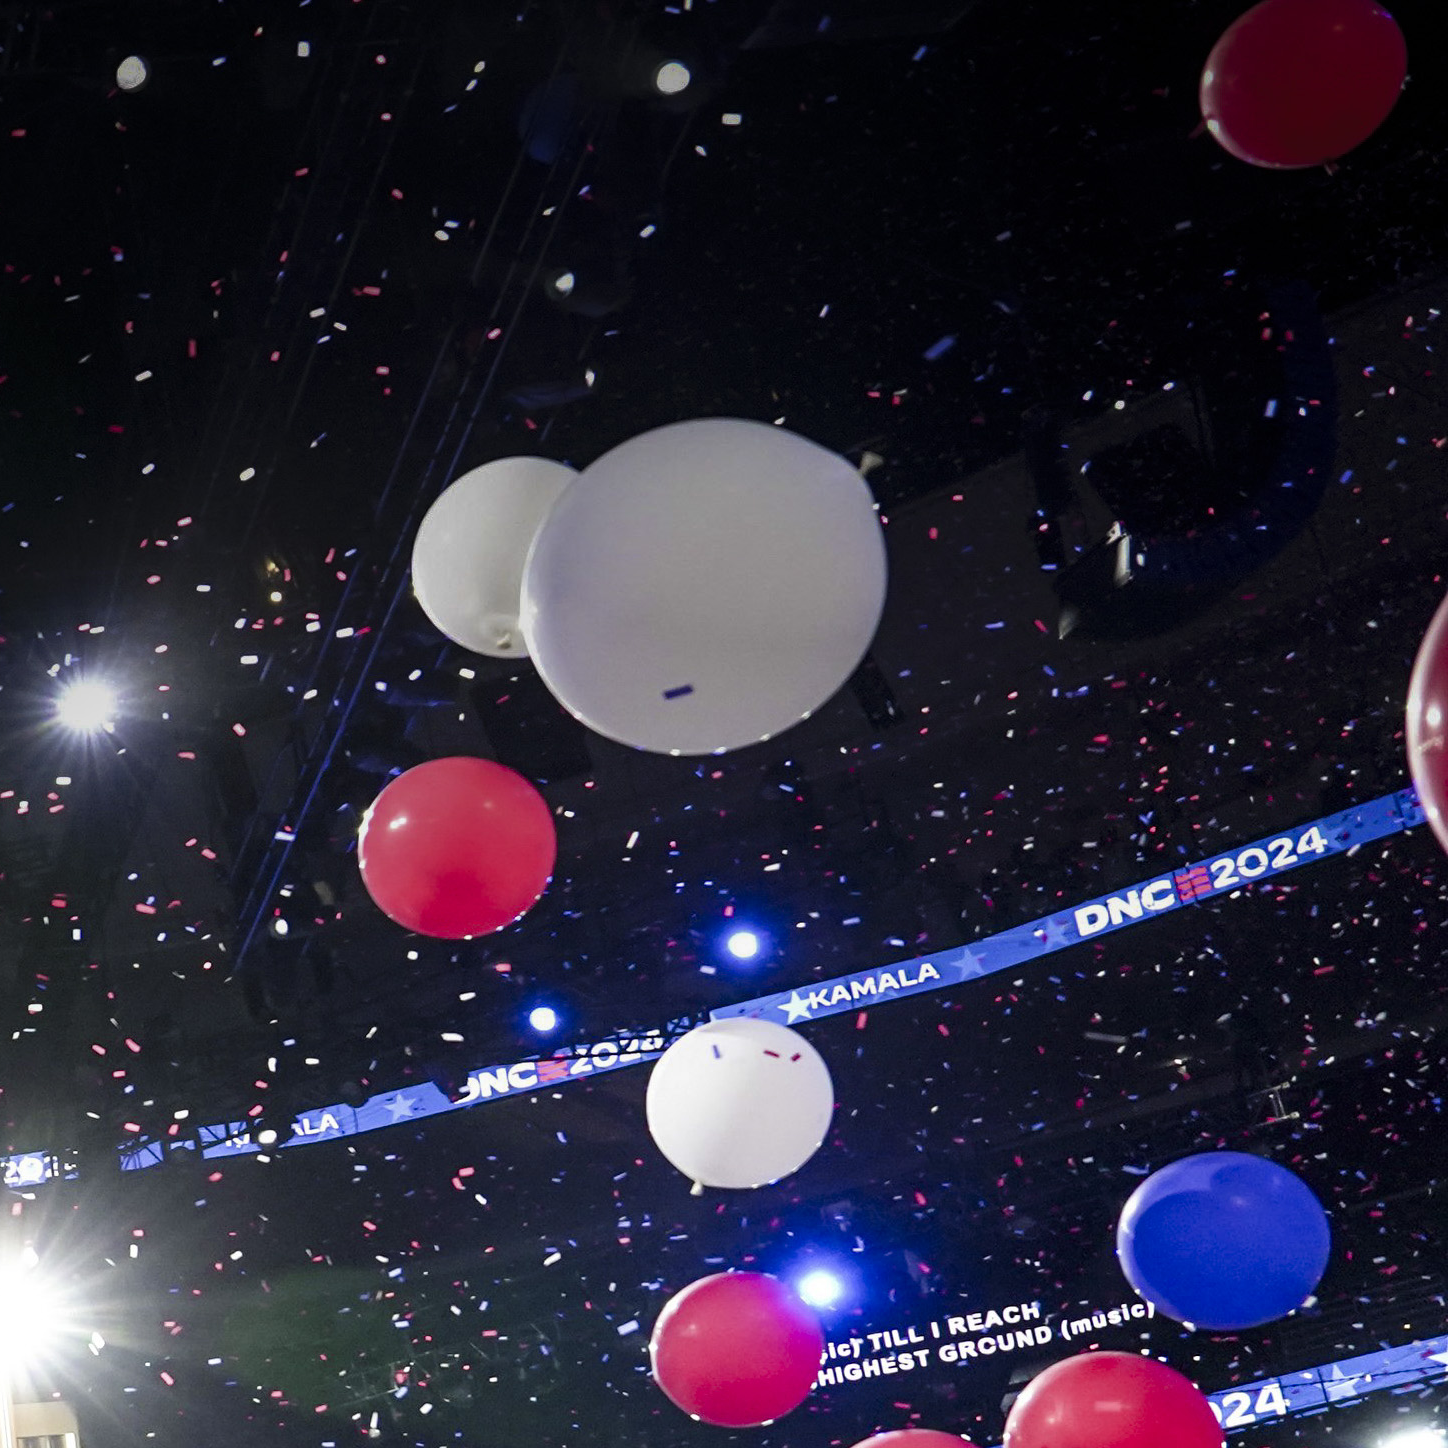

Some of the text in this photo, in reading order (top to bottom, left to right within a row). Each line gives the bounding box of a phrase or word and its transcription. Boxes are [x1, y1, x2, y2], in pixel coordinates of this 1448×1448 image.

[1208, 825, 1328, 890] 2024
[808, 962, 940, 1010] KAMALA
[817, 1298, 1156, 1388] HIGHEST GROUND (music)
[867, 1327, 924, 1353] TILL
[930, 1321, 941, 1339] I
[947, 1303, 1040, 1336] REACH
